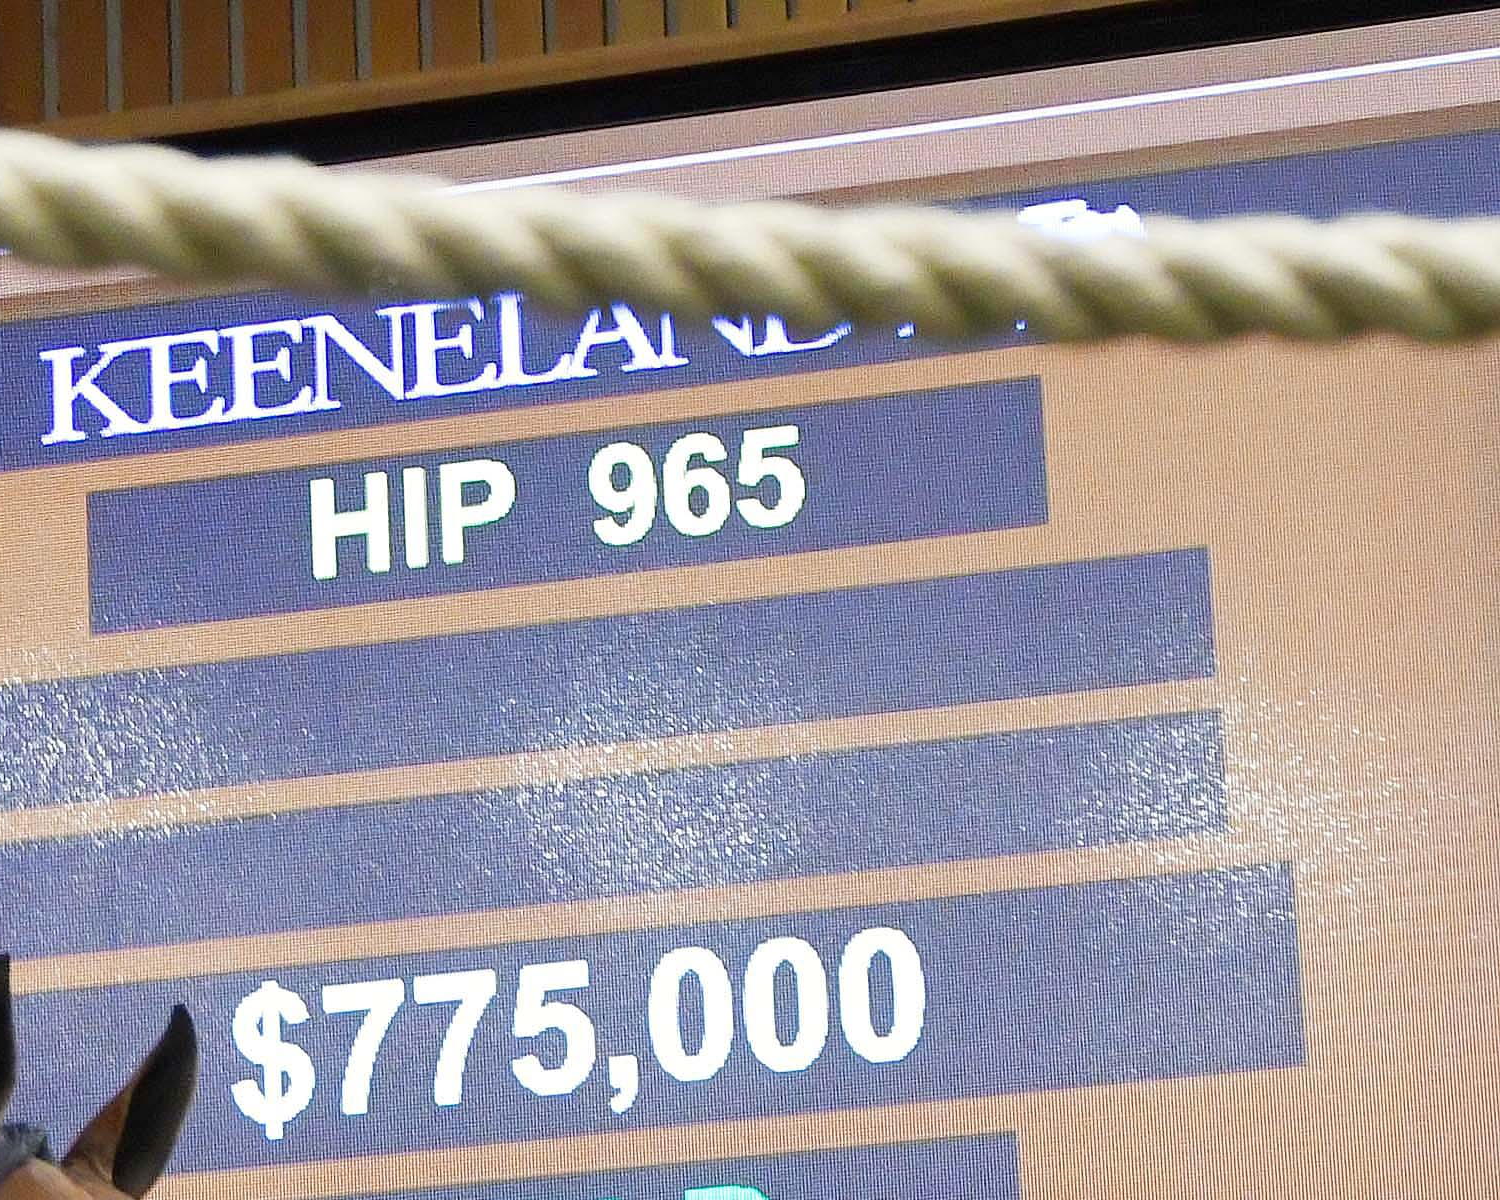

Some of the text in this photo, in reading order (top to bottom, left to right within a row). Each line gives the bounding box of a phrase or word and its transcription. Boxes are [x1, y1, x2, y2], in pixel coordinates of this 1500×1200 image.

[308, 425, 807, 581] HIP 965
[230, 926, 927, 1140] $775,000
